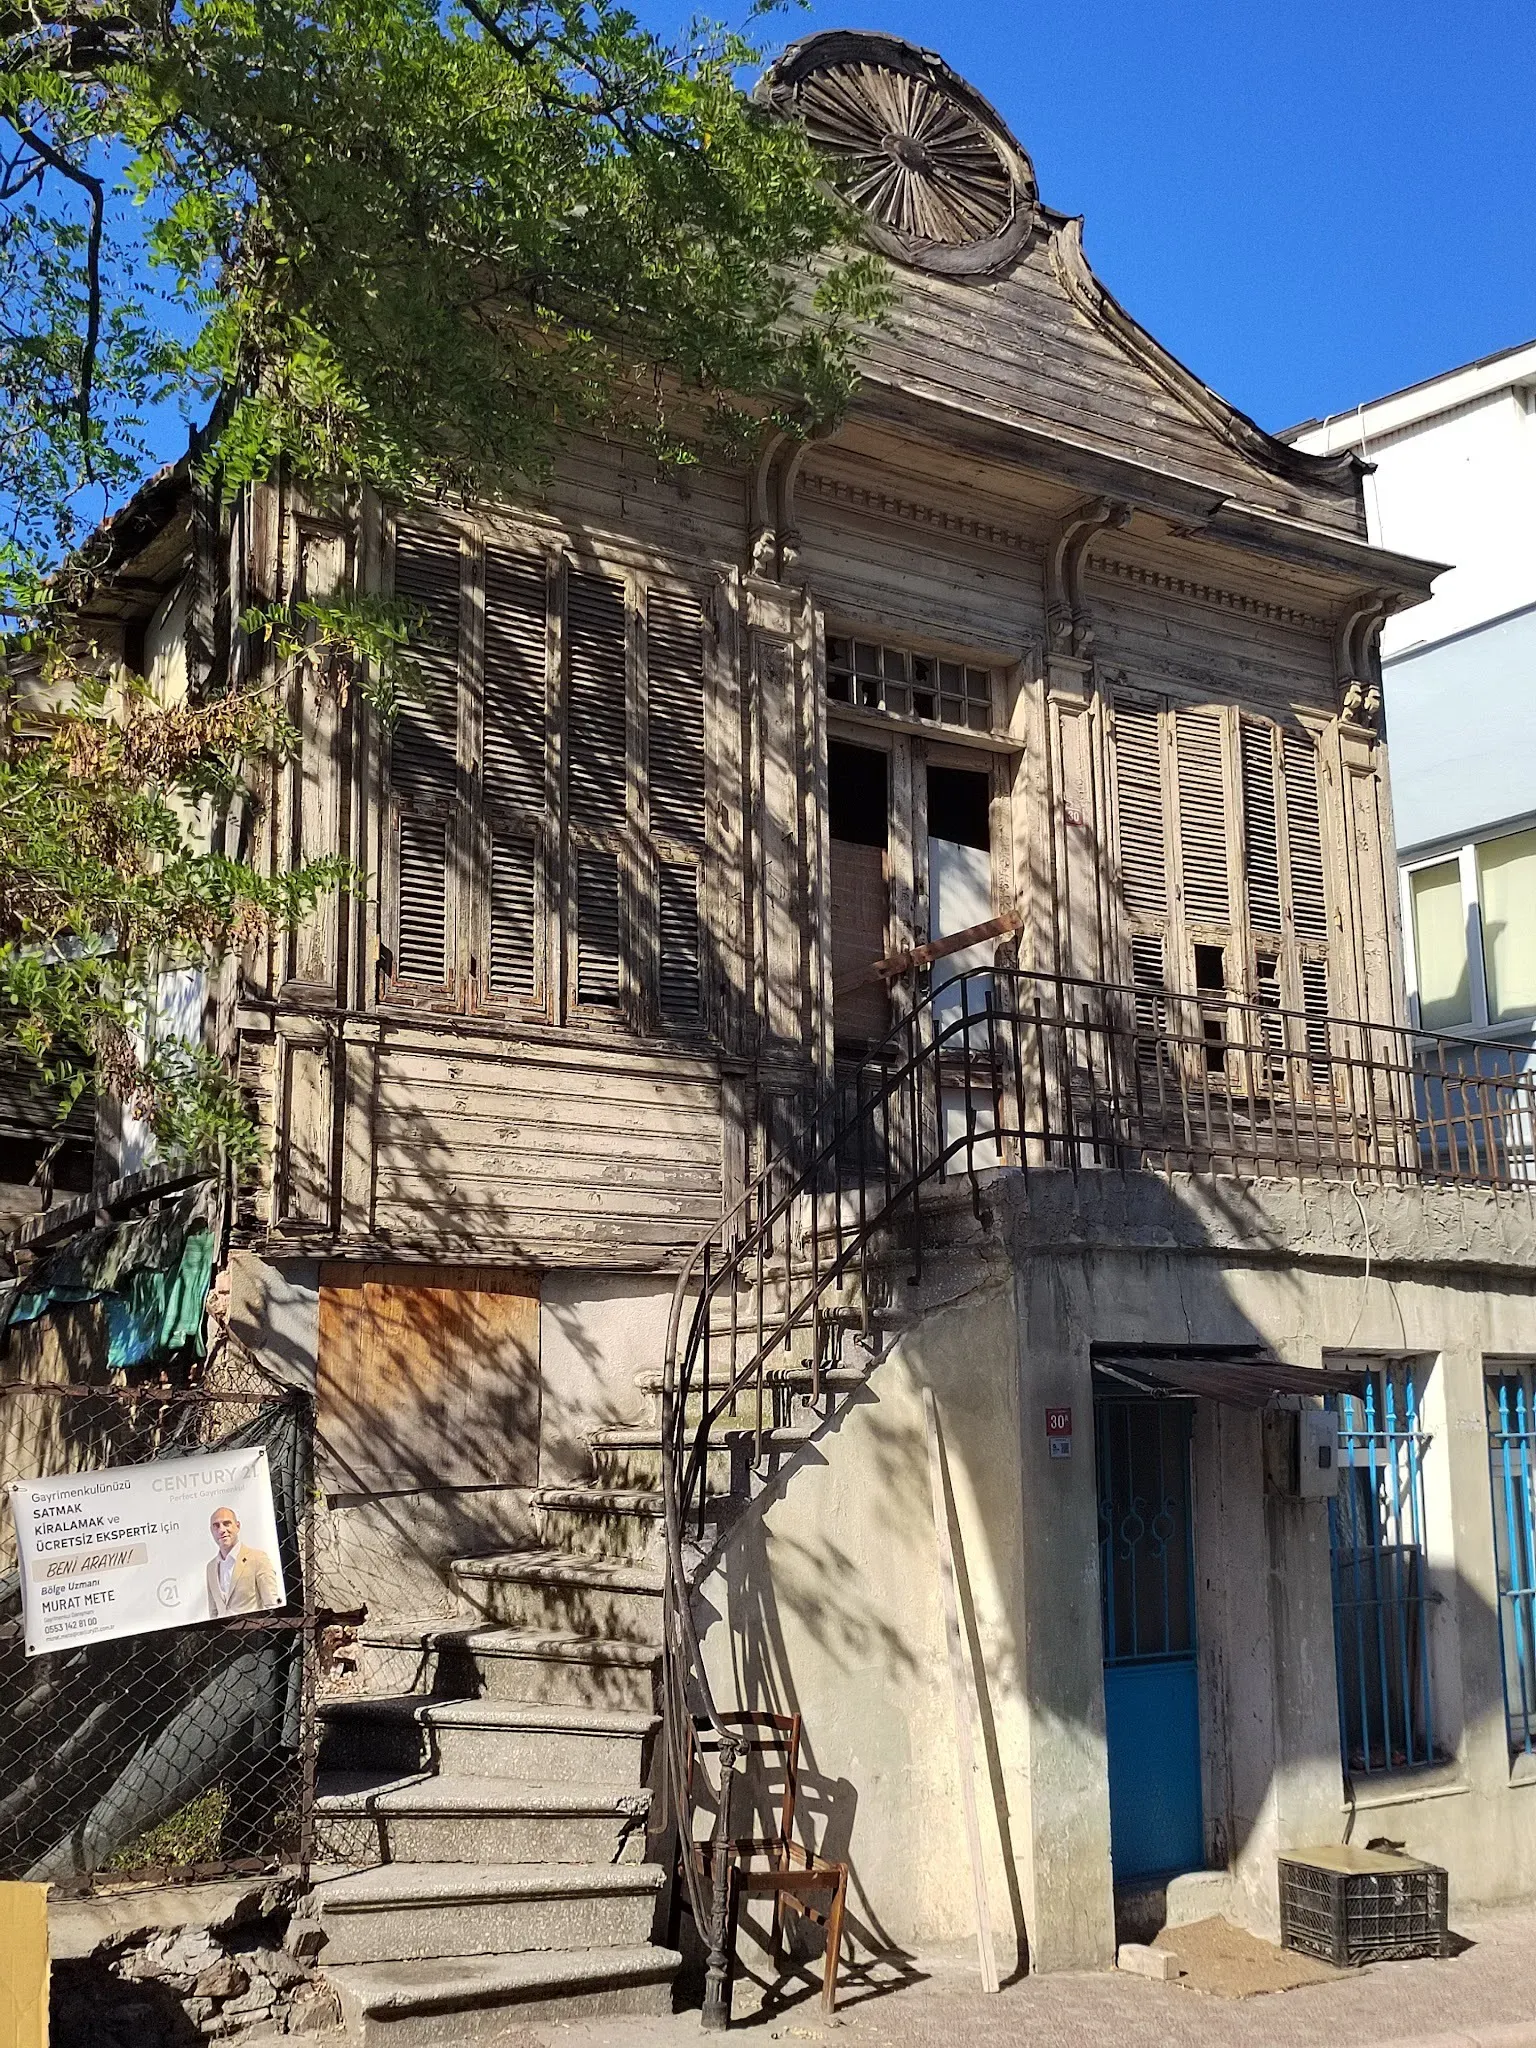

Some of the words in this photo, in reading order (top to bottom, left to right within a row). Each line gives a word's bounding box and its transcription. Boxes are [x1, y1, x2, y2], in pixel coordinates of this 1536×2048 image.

[1068, 811, 1079, 822] 30
[152, 1467, 237, 1492] CENTURY
[242, 1464, 257, 1479] 21
[32, 1480, 131, 1503] Gayrimenkulünüzü
[169, 1492, 198, 1502] Perfect
[33, 1503, 82, 1519] SATMAK
[34, 1516, 105, 1535] KİRALAMAK
[107, 1515, 120, 1524] ve
[36, 1533, 93, 1552] ÜCRETSİZ
[96, 1523, 158, 1542] EKSPERTİZ
[46, 1556, 79, 1578] BENİ
[80, 1549, 133, 1571] ARAYIN!
[41, 1584, 66, 1596] Bölge
[68, 1580, 100, 1590] Uzmanı
[42, 1596, 81, 1613] MURAT
[84, 1590, 115, 1606] METE
[44, 1623, 63, 1634] 0553
